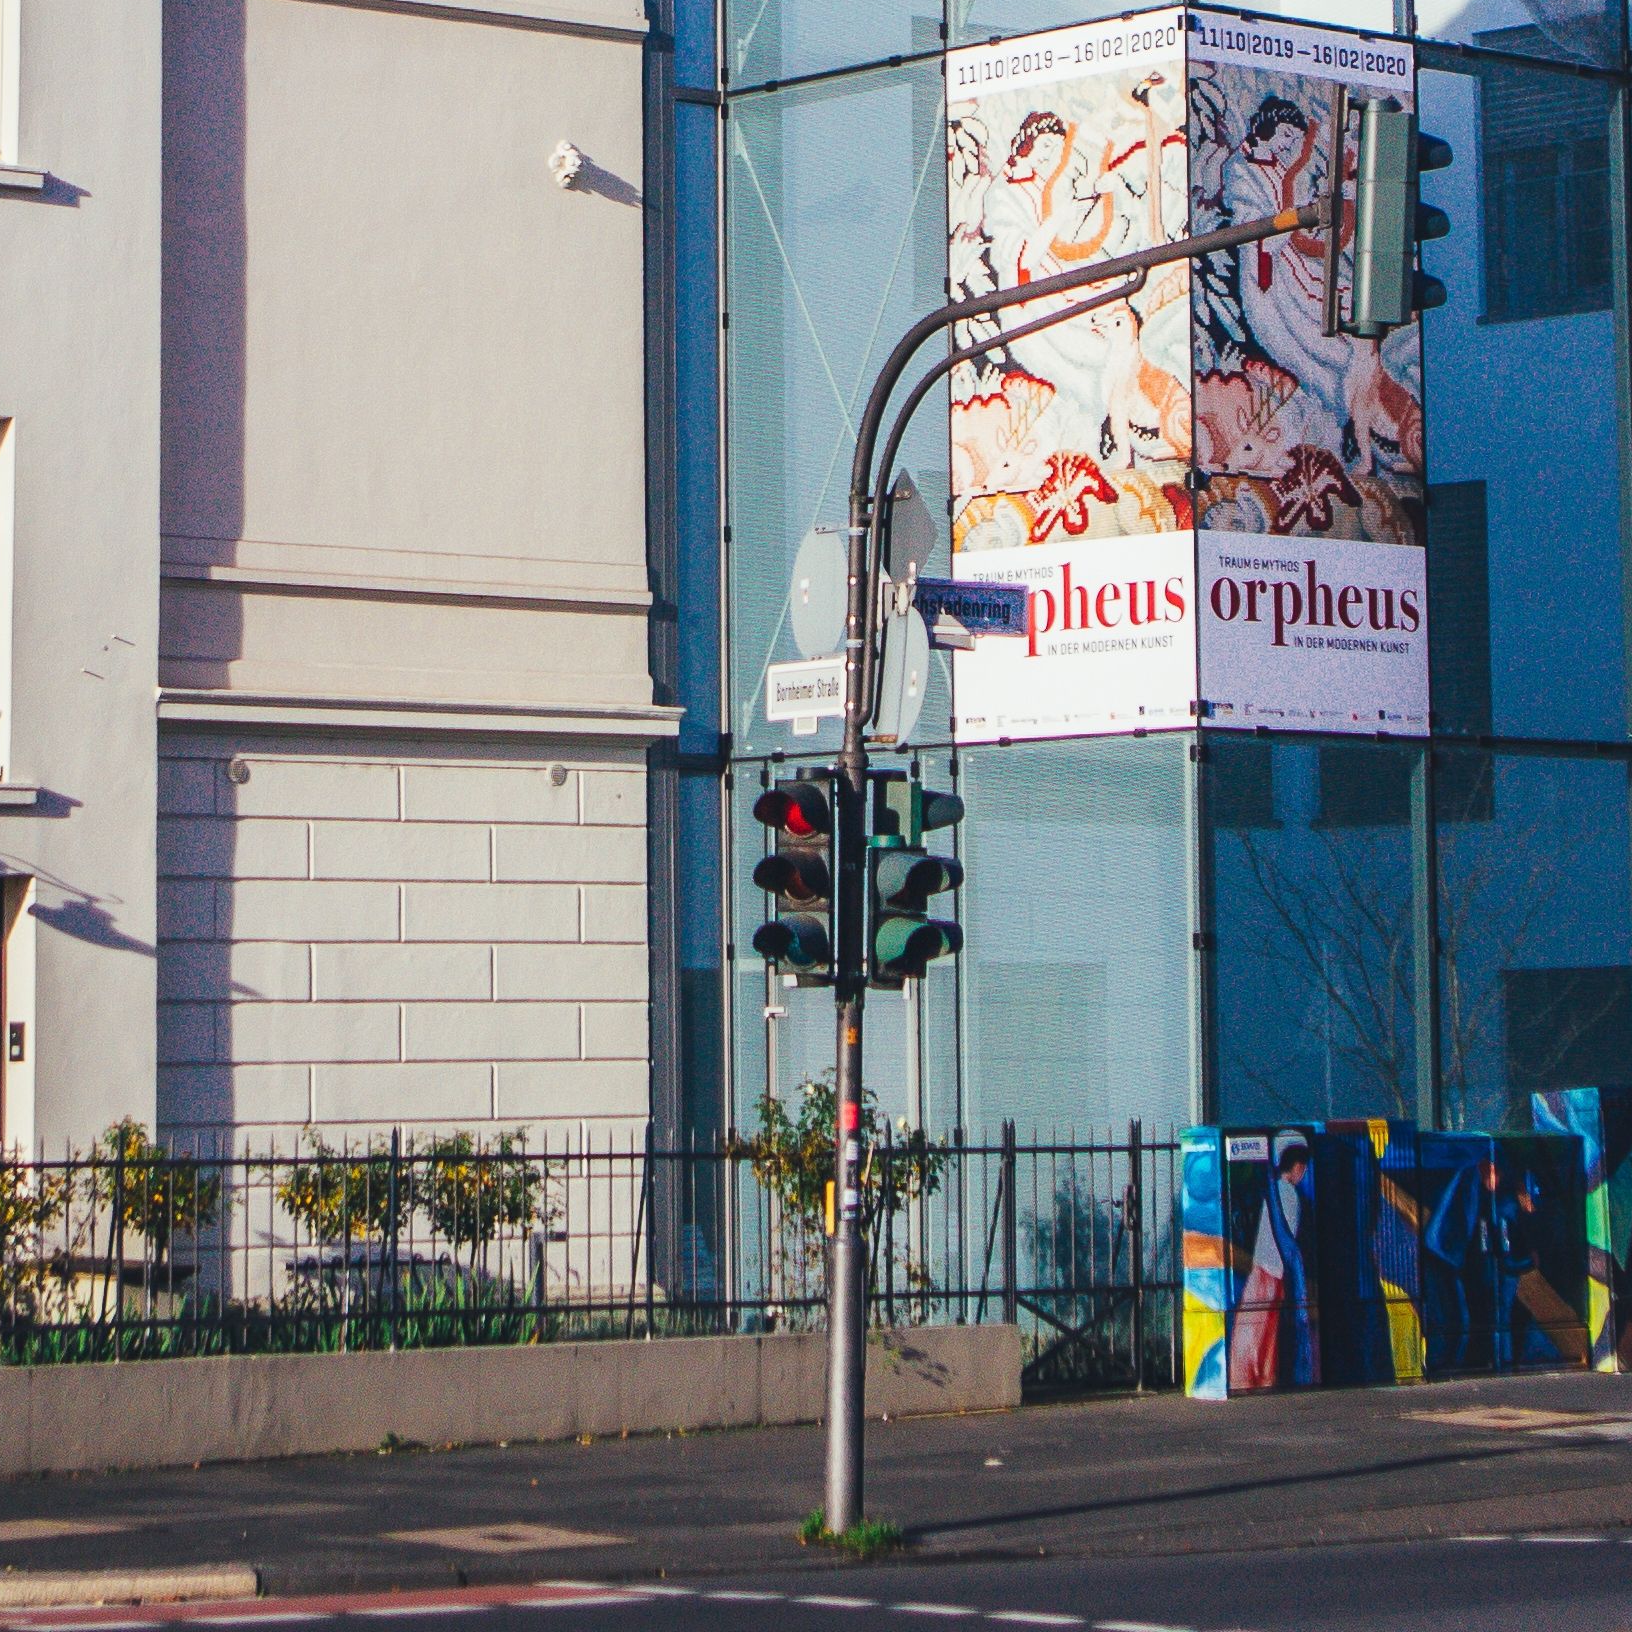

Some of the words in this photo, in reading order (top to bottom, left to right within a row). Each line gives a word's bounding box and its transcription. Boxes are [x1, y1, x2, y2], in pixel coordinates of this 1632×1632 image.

[1219, 555, 1251, 568] TRAUM
[1262, 559, 1300, 573] MYTHOS
[973, 571, 1004, 583] TRAUM
[1015, 567, 1054, 580] MYTHOS
[892, 591, 1010, 624] Hchstadenring
[1024, 561, 1186, 657] pheus
[1210, 560, 1420, 647] orpheus
[1048, 643, 1058, 656] IN
[1061, 642, 1079, 655] DER
[1082, 638, 1138, 654] MODERNEN
[1141, 635, 1174, 649] KUNST
[1294, 636, 1304, 648] IN
[1306, 637, 1325, 649] DER
[1327, 637, 1378, 652] MODERNEN
[1380, 640, 1410, 654] KUNST
[777, 681, 815, 702] Bornheimer
